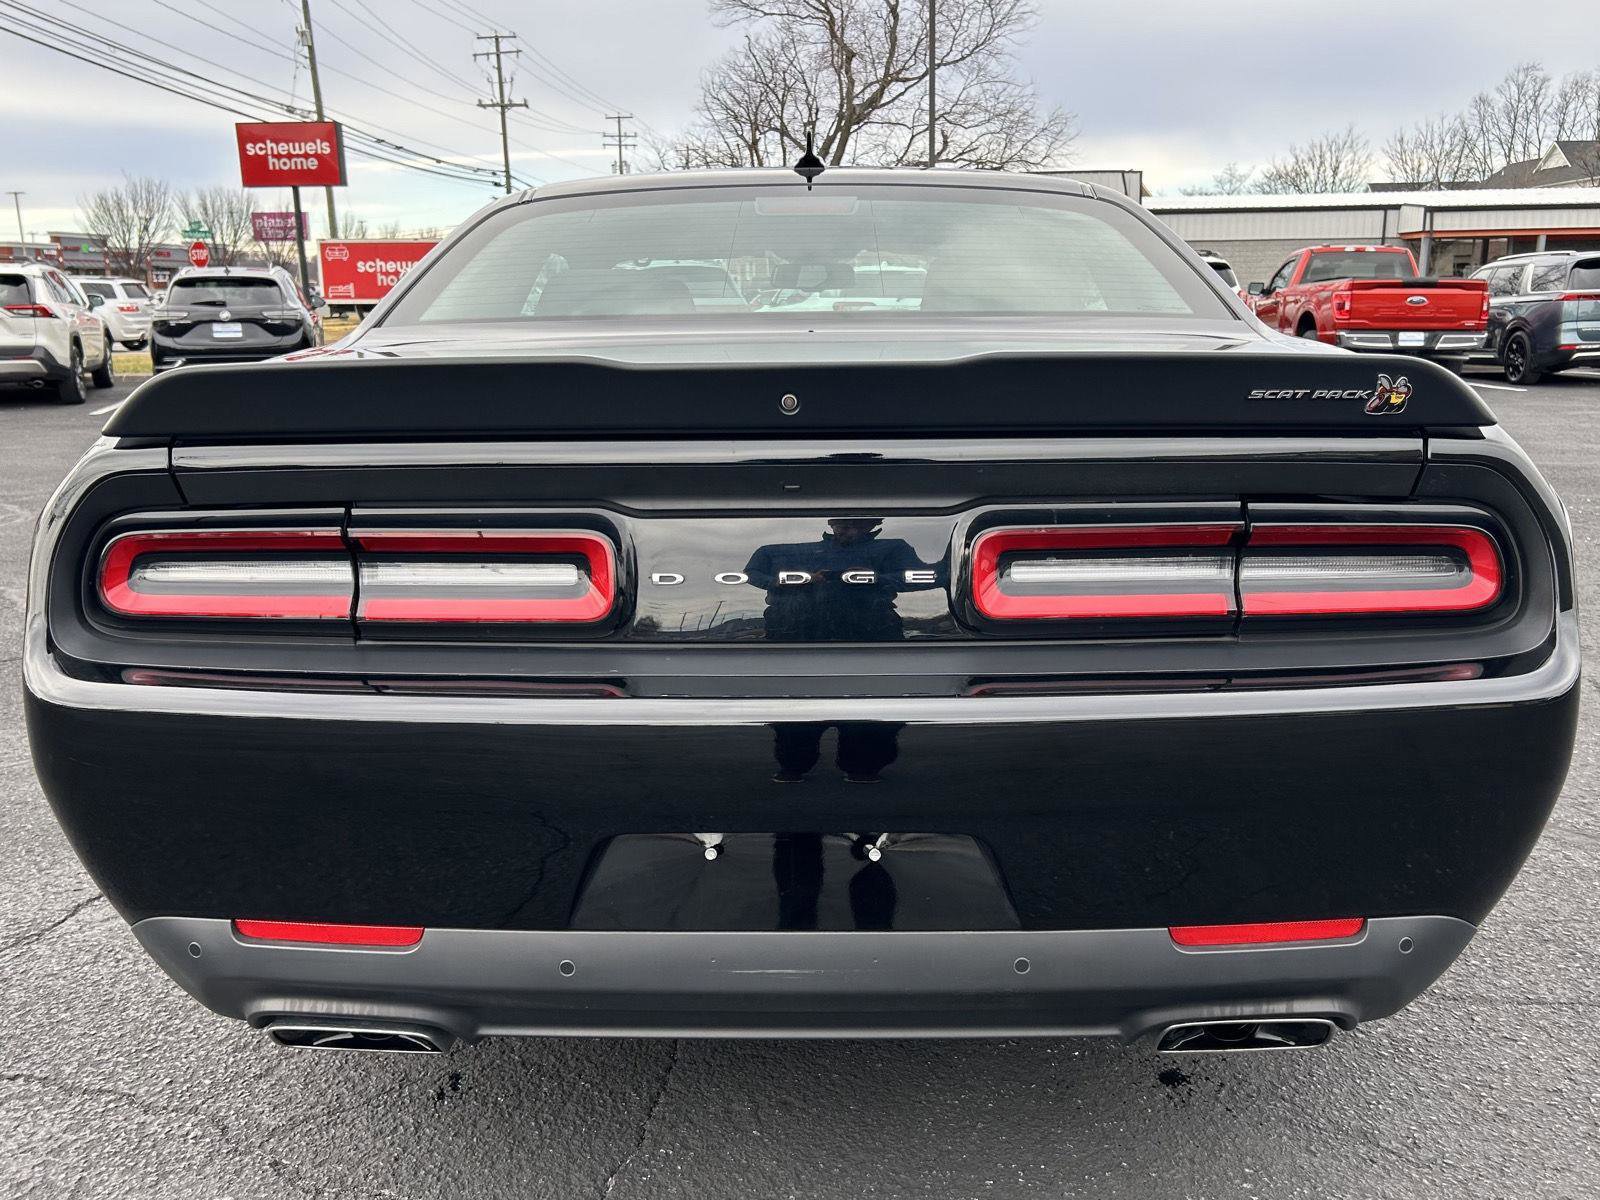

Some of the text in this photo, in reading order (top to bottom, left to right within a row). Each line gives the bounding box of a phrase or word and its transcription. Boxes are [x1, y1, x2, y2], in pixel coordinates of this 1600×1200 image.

[246, 139, 331, 155] schewels
[268, 155, 319, 170] home
[191, 249, 209, 260] STOP
[377, 272, 401, 286] ho
[1248, 389, 1373, 399] SCAT PACK
[651, 570, 938, 586] DODGE
